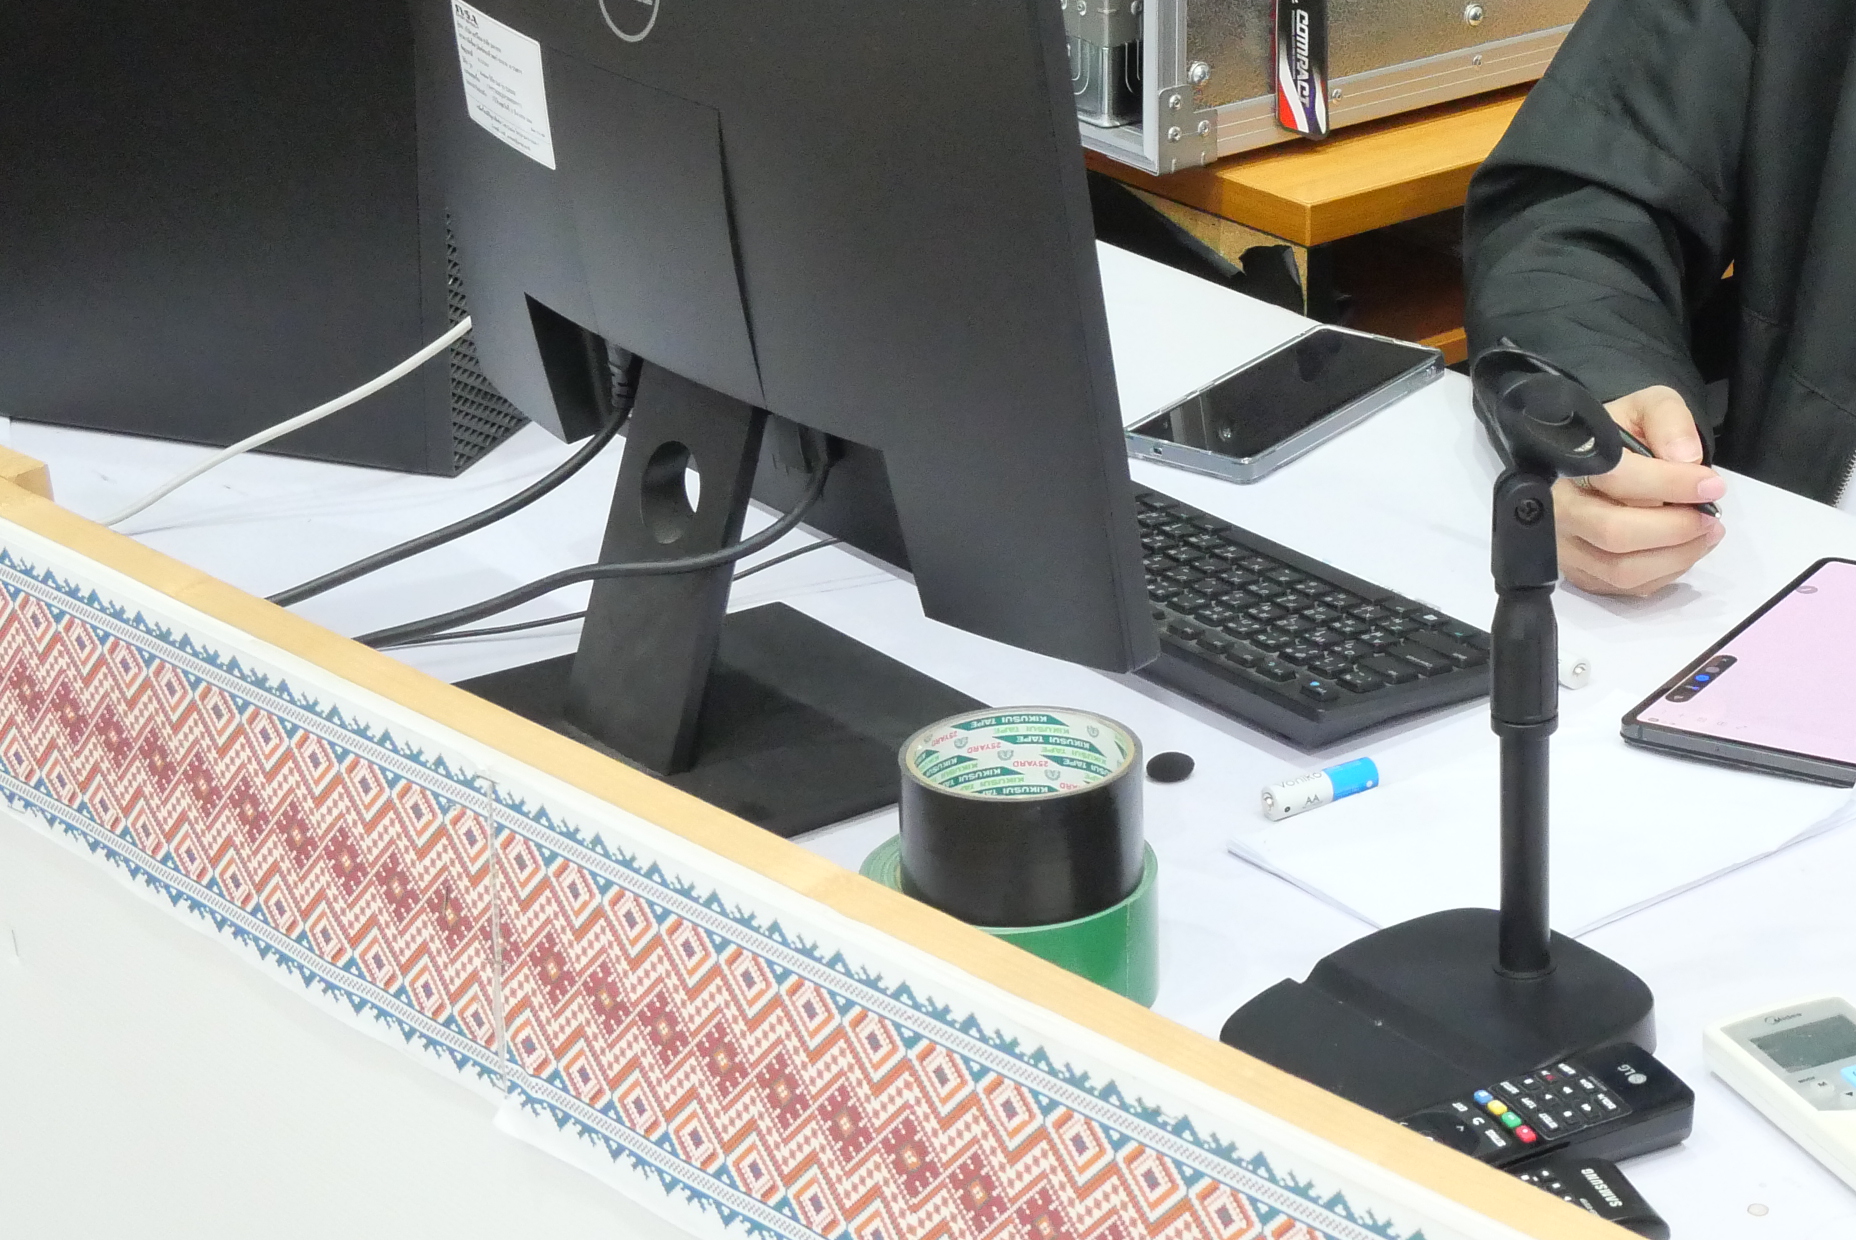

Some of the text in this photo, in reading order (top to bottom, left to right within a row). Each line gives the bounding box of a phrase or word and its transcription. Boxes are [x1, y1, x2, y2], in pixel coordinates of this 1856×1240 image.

[1296, 8, 1311, 109] COMPACT
[970, 715, 1047, 728] KIKUSUI TAPE
[931, 730, 958, 746] 25YARD
[1016, 735, 1090, 749] KIKUSUI TAPE
[967, 742, 1001, 754] 25YARD
[1013, 760, 1048, 768] 25YARD
[1062, 758, 1087, 769] TAPE
[958, 768, 1000, 781] KIKUSUI
[1002, 786, 1049, 795] KIKUSUI
[1305, 794, 1320, 805] AA
[1617, 1063, 1636, 1077] LG
[1581, 1168, 1622, 1208] SAMSUNG
